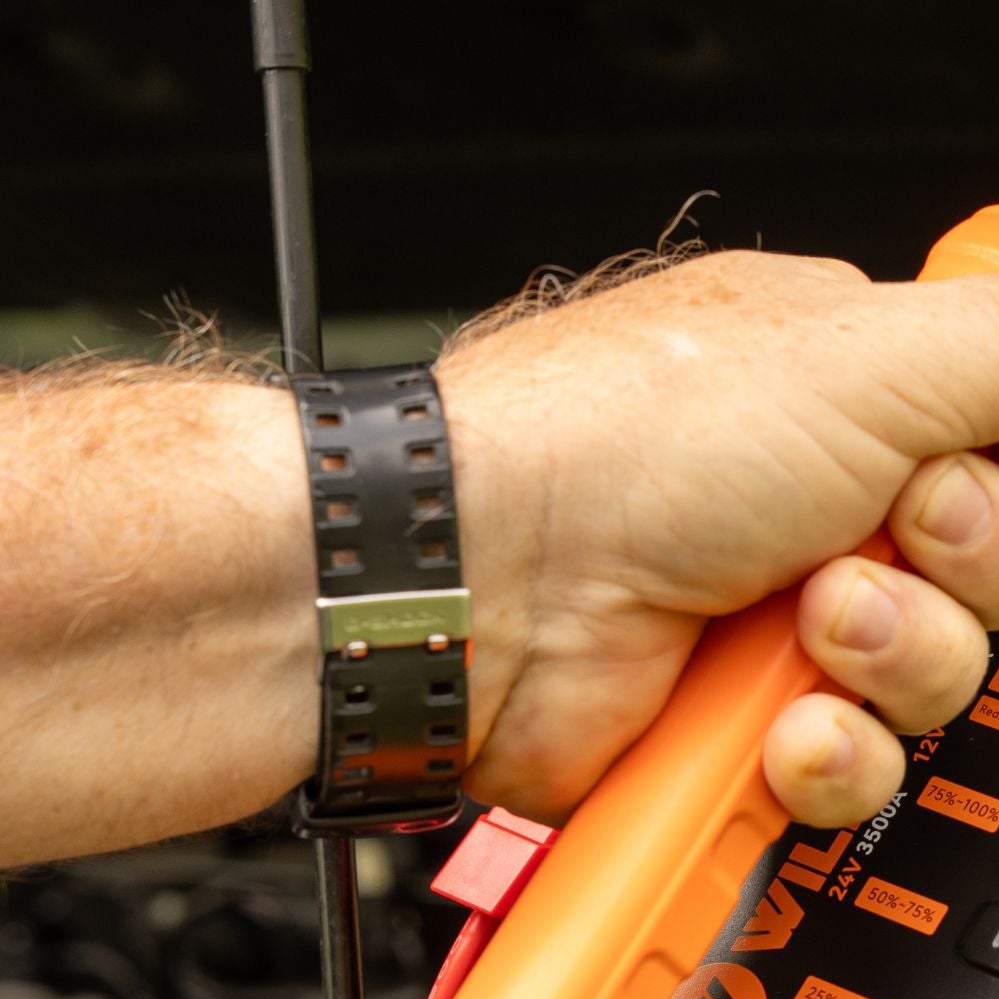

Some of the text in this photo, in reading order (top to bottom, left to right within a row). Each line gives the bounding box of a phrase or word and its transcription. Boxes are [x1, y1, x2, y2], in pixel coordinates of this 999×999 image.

[730, 822, 861, 952] WIL
[828, 857, 862, 901] 24V
[856, 792, 908, 856] 3500A
